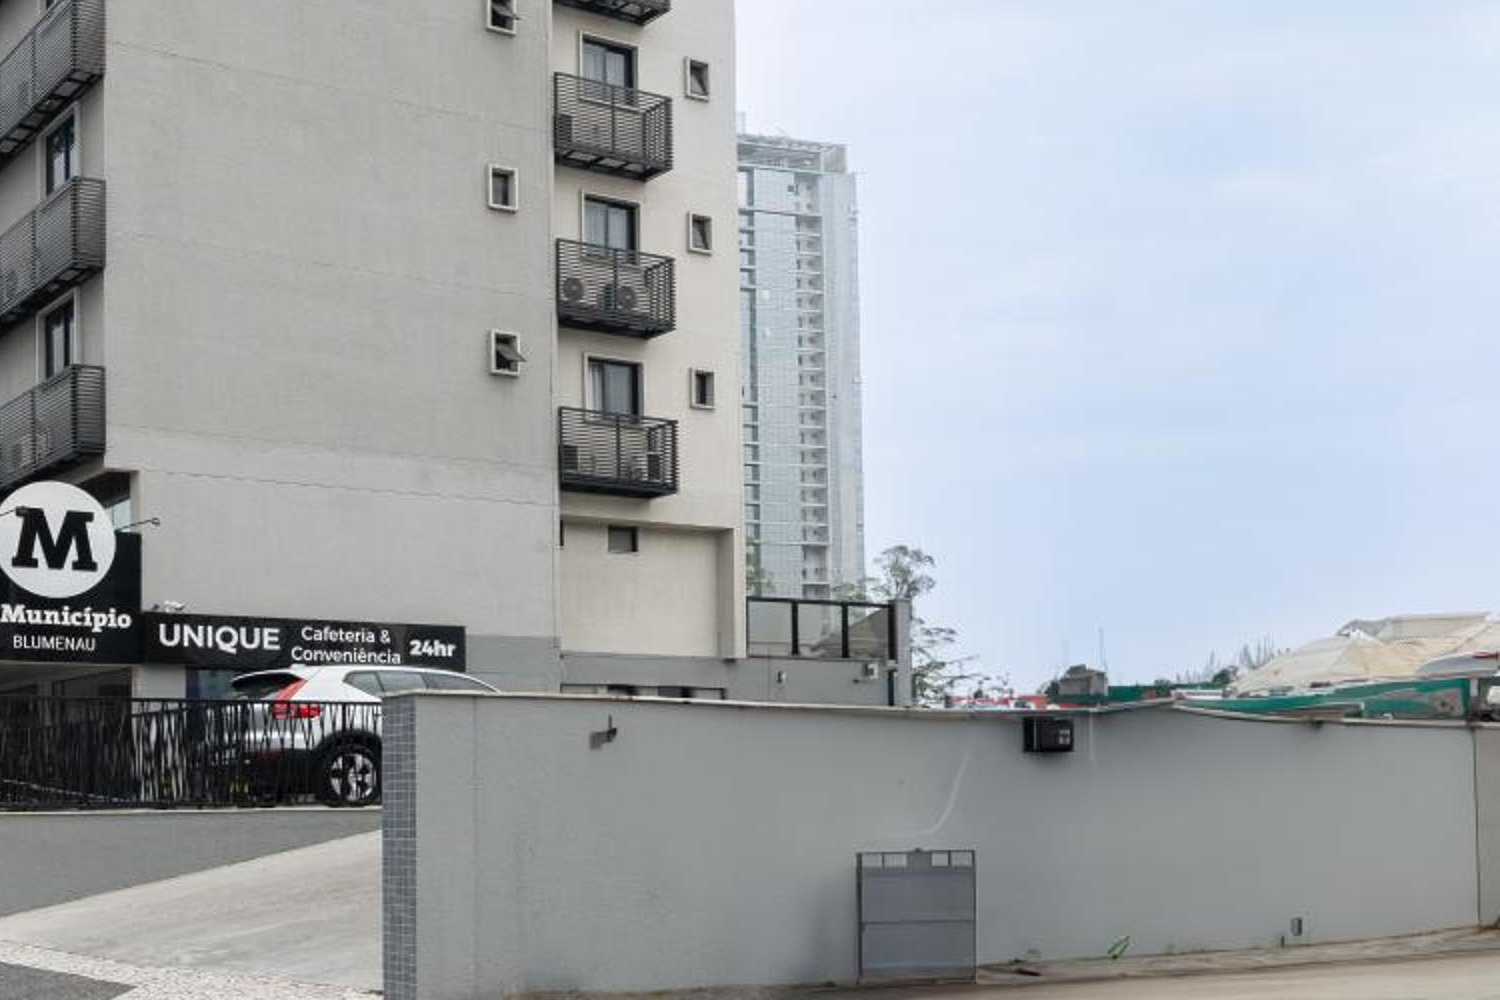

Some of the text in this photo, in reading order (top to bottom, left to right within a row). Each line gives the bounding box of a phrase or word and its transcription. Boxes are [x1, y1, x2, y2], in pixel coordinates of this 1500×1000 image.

[11, 506, 98, 572] M
[0, 603, 132, 633] Município
[12, 634, 97, 651] BLUMENAU
[159, 623, 281, 655] UNIQUE
[301, 625, 391, 644] Cafeteria &
[291, 645, 402, 665] Conveniência
[409, 639, 457, 658] 24hr
